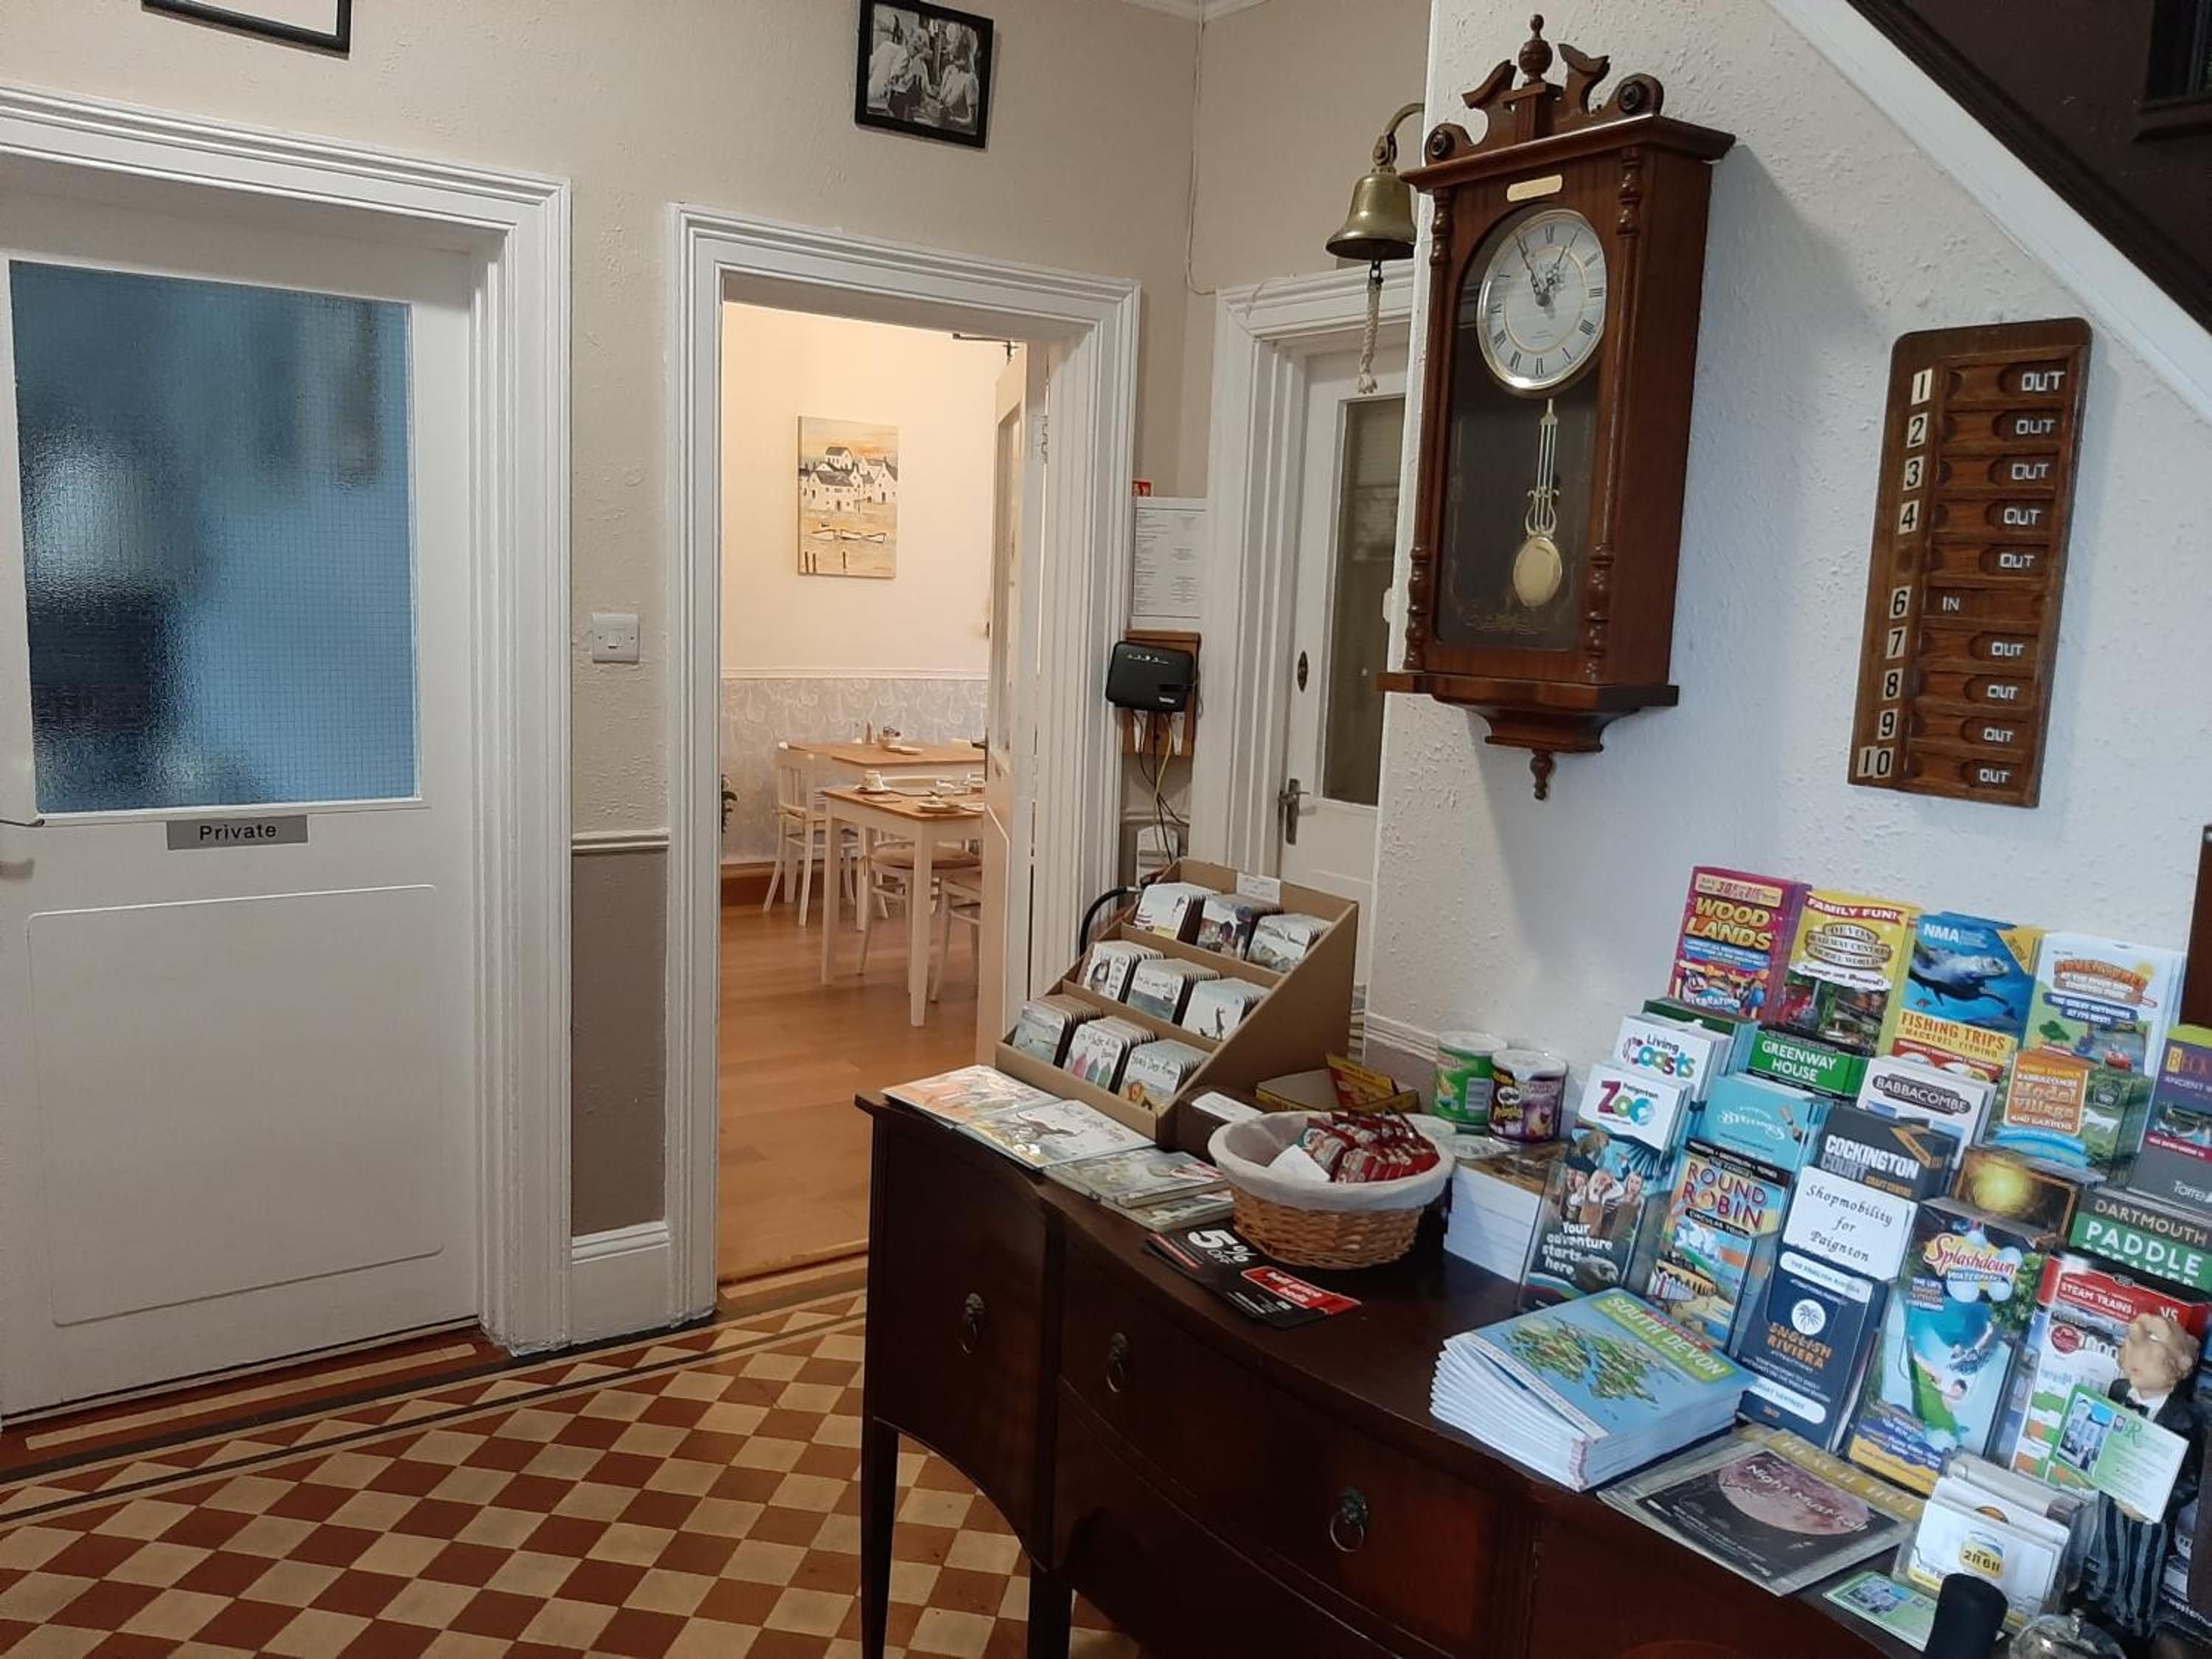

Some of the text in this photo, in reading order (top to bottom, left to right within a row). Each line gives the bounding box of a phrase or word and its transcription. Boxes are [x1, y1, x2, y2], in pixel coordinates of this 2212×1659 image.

[2021, 371, 2066, 392] OUT
[1909, 416, 2056, 445] 2 OUT
[1905, 459, 2050, 487] 3 OUT
[1901, 503, 2042, 530] 4 OUT
[1999, 553, 2035, 568] OUT
[1893, 589, 1960, 616] 6 IN
[1889, 629, 2025, 656] 7 OUT
[1885, 672, 2018, 700] 8 OUT
[1881, 711, 2014, 742] 9 OUT
[1863, 748, 2011, 783] 10 OUT
[200, 824, 277, 841] Private
[1696, 897, 1771, 927] WOOD
[1807, 897, 1898, 920] FAMILY FUN!
[1685, 917, 1774, 951] LANDS
[1923, 923, 1961, 944] NMA
[1646, 1034, 1680, 1054] Living
[1901, 1012, 2006, 1051] FISHING TRIPS
[1761, 1039, 1838, 1073] GREENWAY
[1770, 1058, 1818, 1083] HOUSE
[1874, 1077, 1969, 1114] BABBACOMBE
[1820, 1152, 1869, 1181] COURT
[1824, 1134, 1920, 1180] COCKINGTON
[1687, 1161, 1767, 1206] ROUND
[1682, 1181, 1763, 1229] ROBIN
[1806, 1183, 1894, 1228] Shopmobility
[1562, 1222, 1590, 1236] Your
[1832, 1215, 1857, 1233] for
[2094, 1199, 2208, 1247] DARTMOUTH
[1187, 1229, 1257, 1262] 5%
[1541, 1243, 1581, 1262] starts
[1545, 1233, 1613, 1251] adventure
[1809, 1229, 1870, 1262] Paignton
[1924, 1234, 2017, 1276] Splashdown
[2085, 1220, 2204, 1278] PADDLE
[2062, 1281, 2133, 1315] STEAM TRAINS
[1606, 1297, 1667, 1335] SOUTH
[1662, 1336, 1726, 1375] DEVON
[1769, 1321, 1832, 1359] ENGLISH
[1767, 1335, 1824, 1369] RIVIERA
